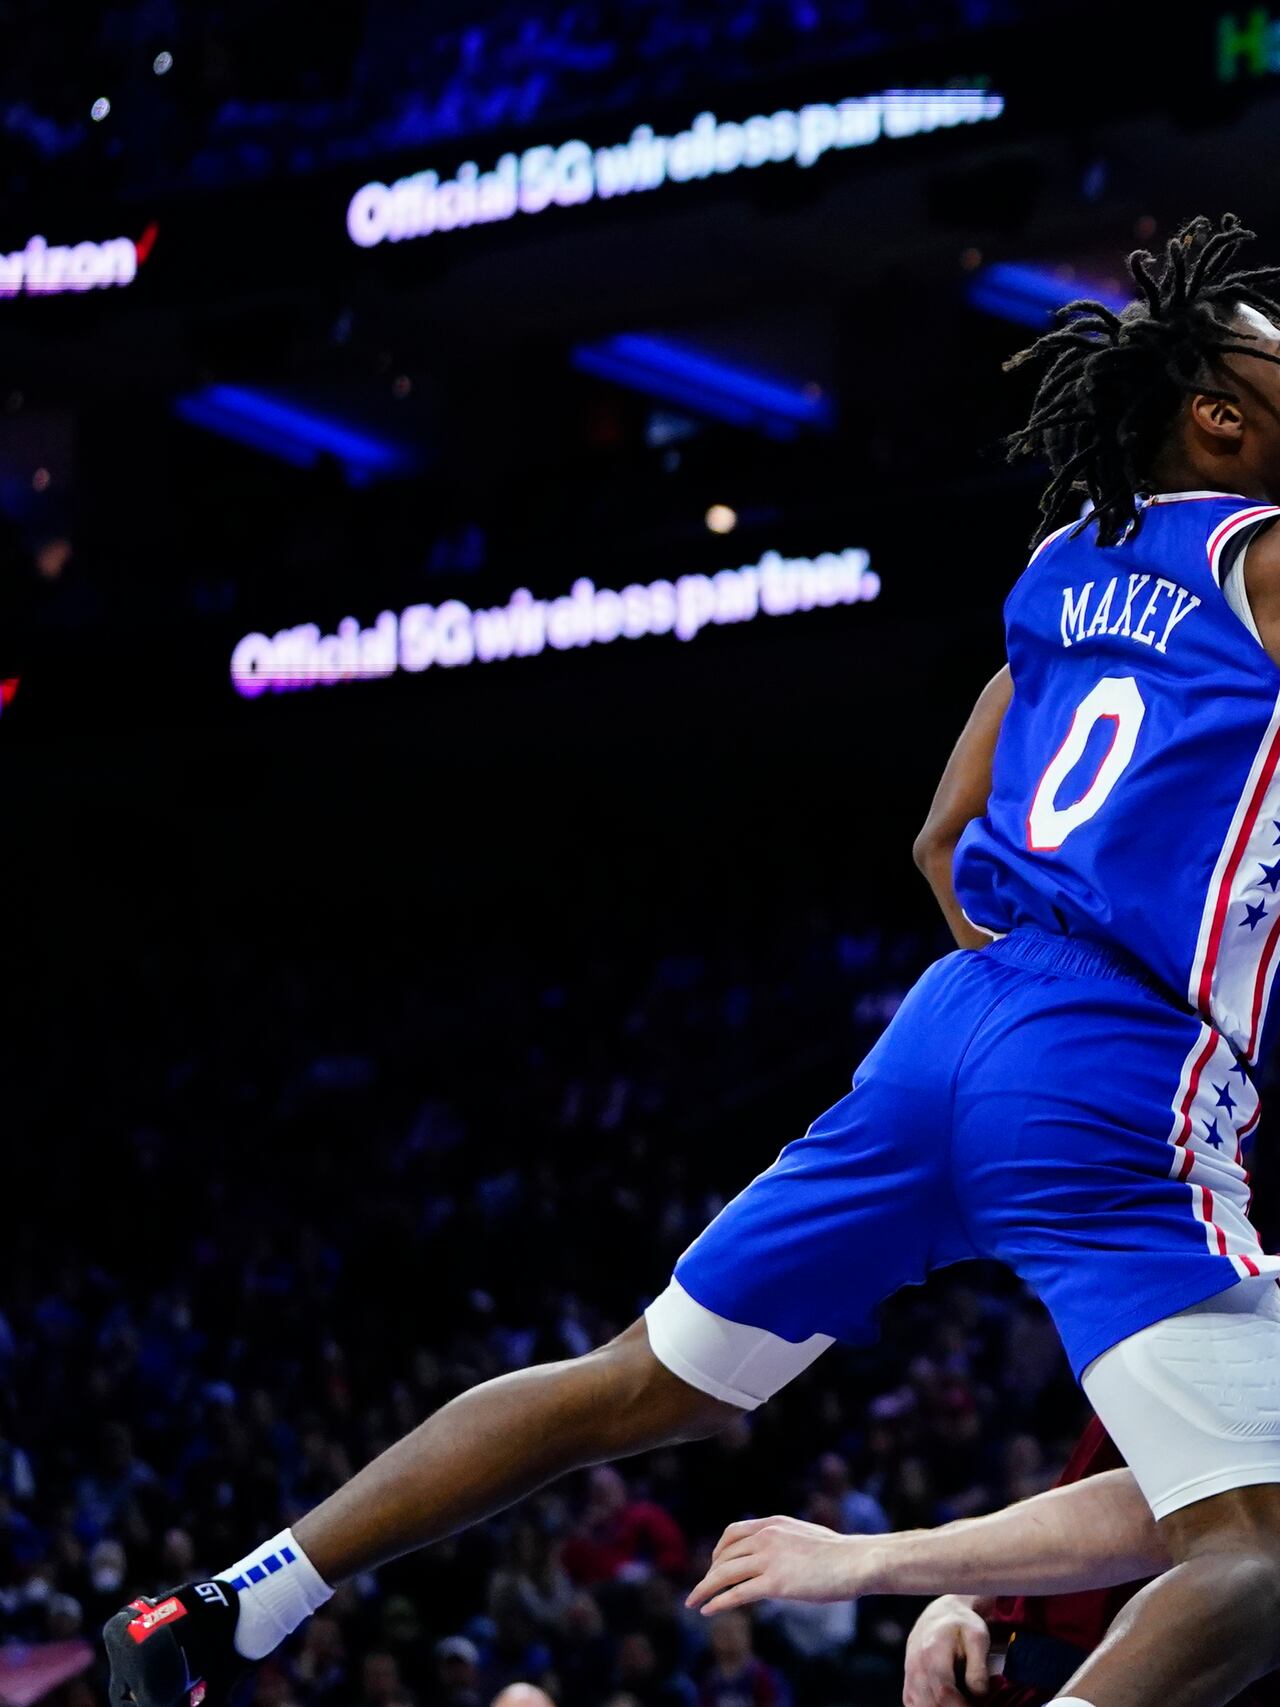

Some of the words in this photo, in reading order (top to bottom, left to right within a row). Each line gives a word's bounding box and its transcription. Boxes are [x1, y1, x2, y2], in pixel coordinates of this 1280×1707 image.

[346, 152, 518, 249] Official
[518, 138, 594, 214] 5G
[594, 110, 797, 200] wireless
[0, 234, 138, 297] rizon
[230, 608, 399, 700] Official
[399, 598, 474, 673] 5G
[474, 576, 676, 664] wireless
[1060, 573, 1201, 655] MAXEY
[1025, 676, 1146, 852] 0
[194, 1582, 230, 1607] GT
